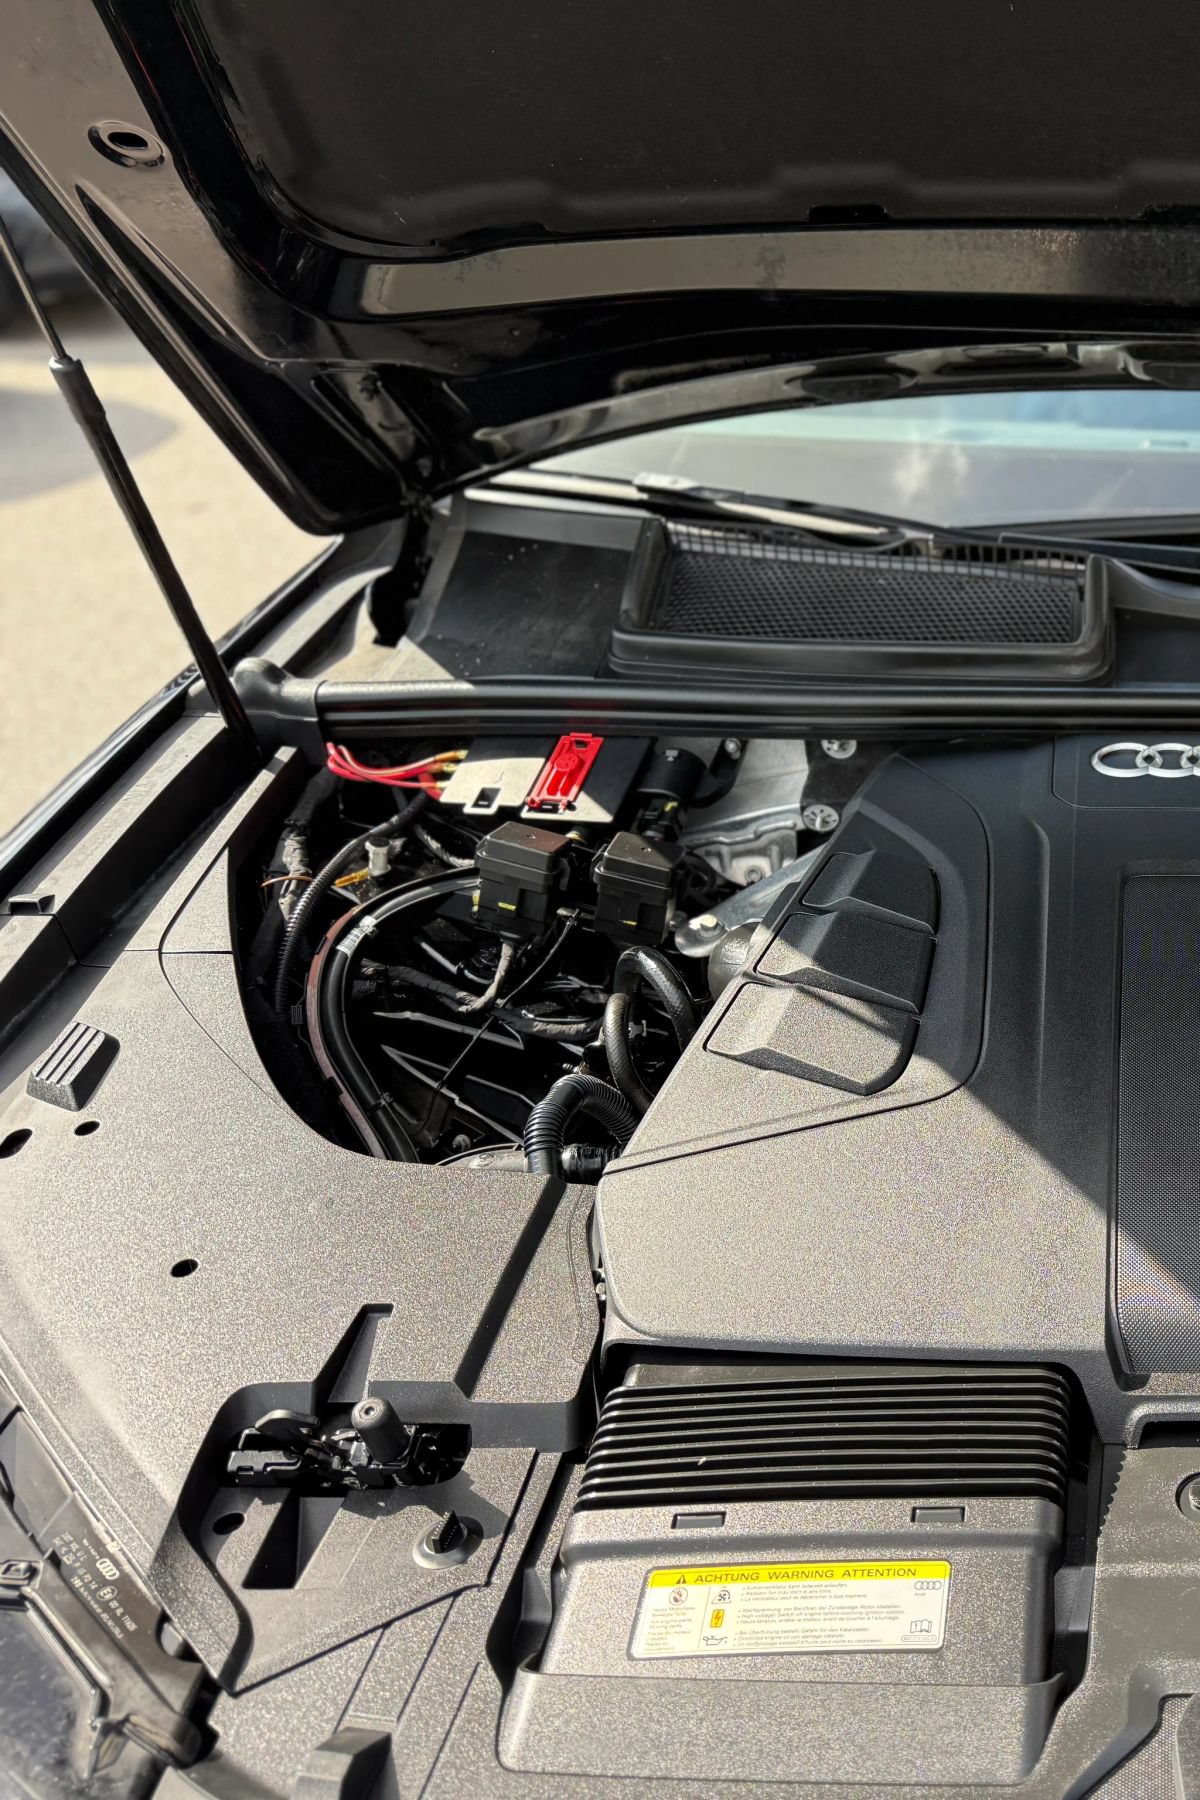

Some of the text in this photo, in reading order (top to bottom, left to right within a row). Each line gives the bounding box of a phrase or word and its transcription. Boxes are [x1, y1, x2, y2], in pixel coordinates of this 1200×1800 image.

[694, 1568, 917, 1583] ACHTUNG WARNING ATTENTION
